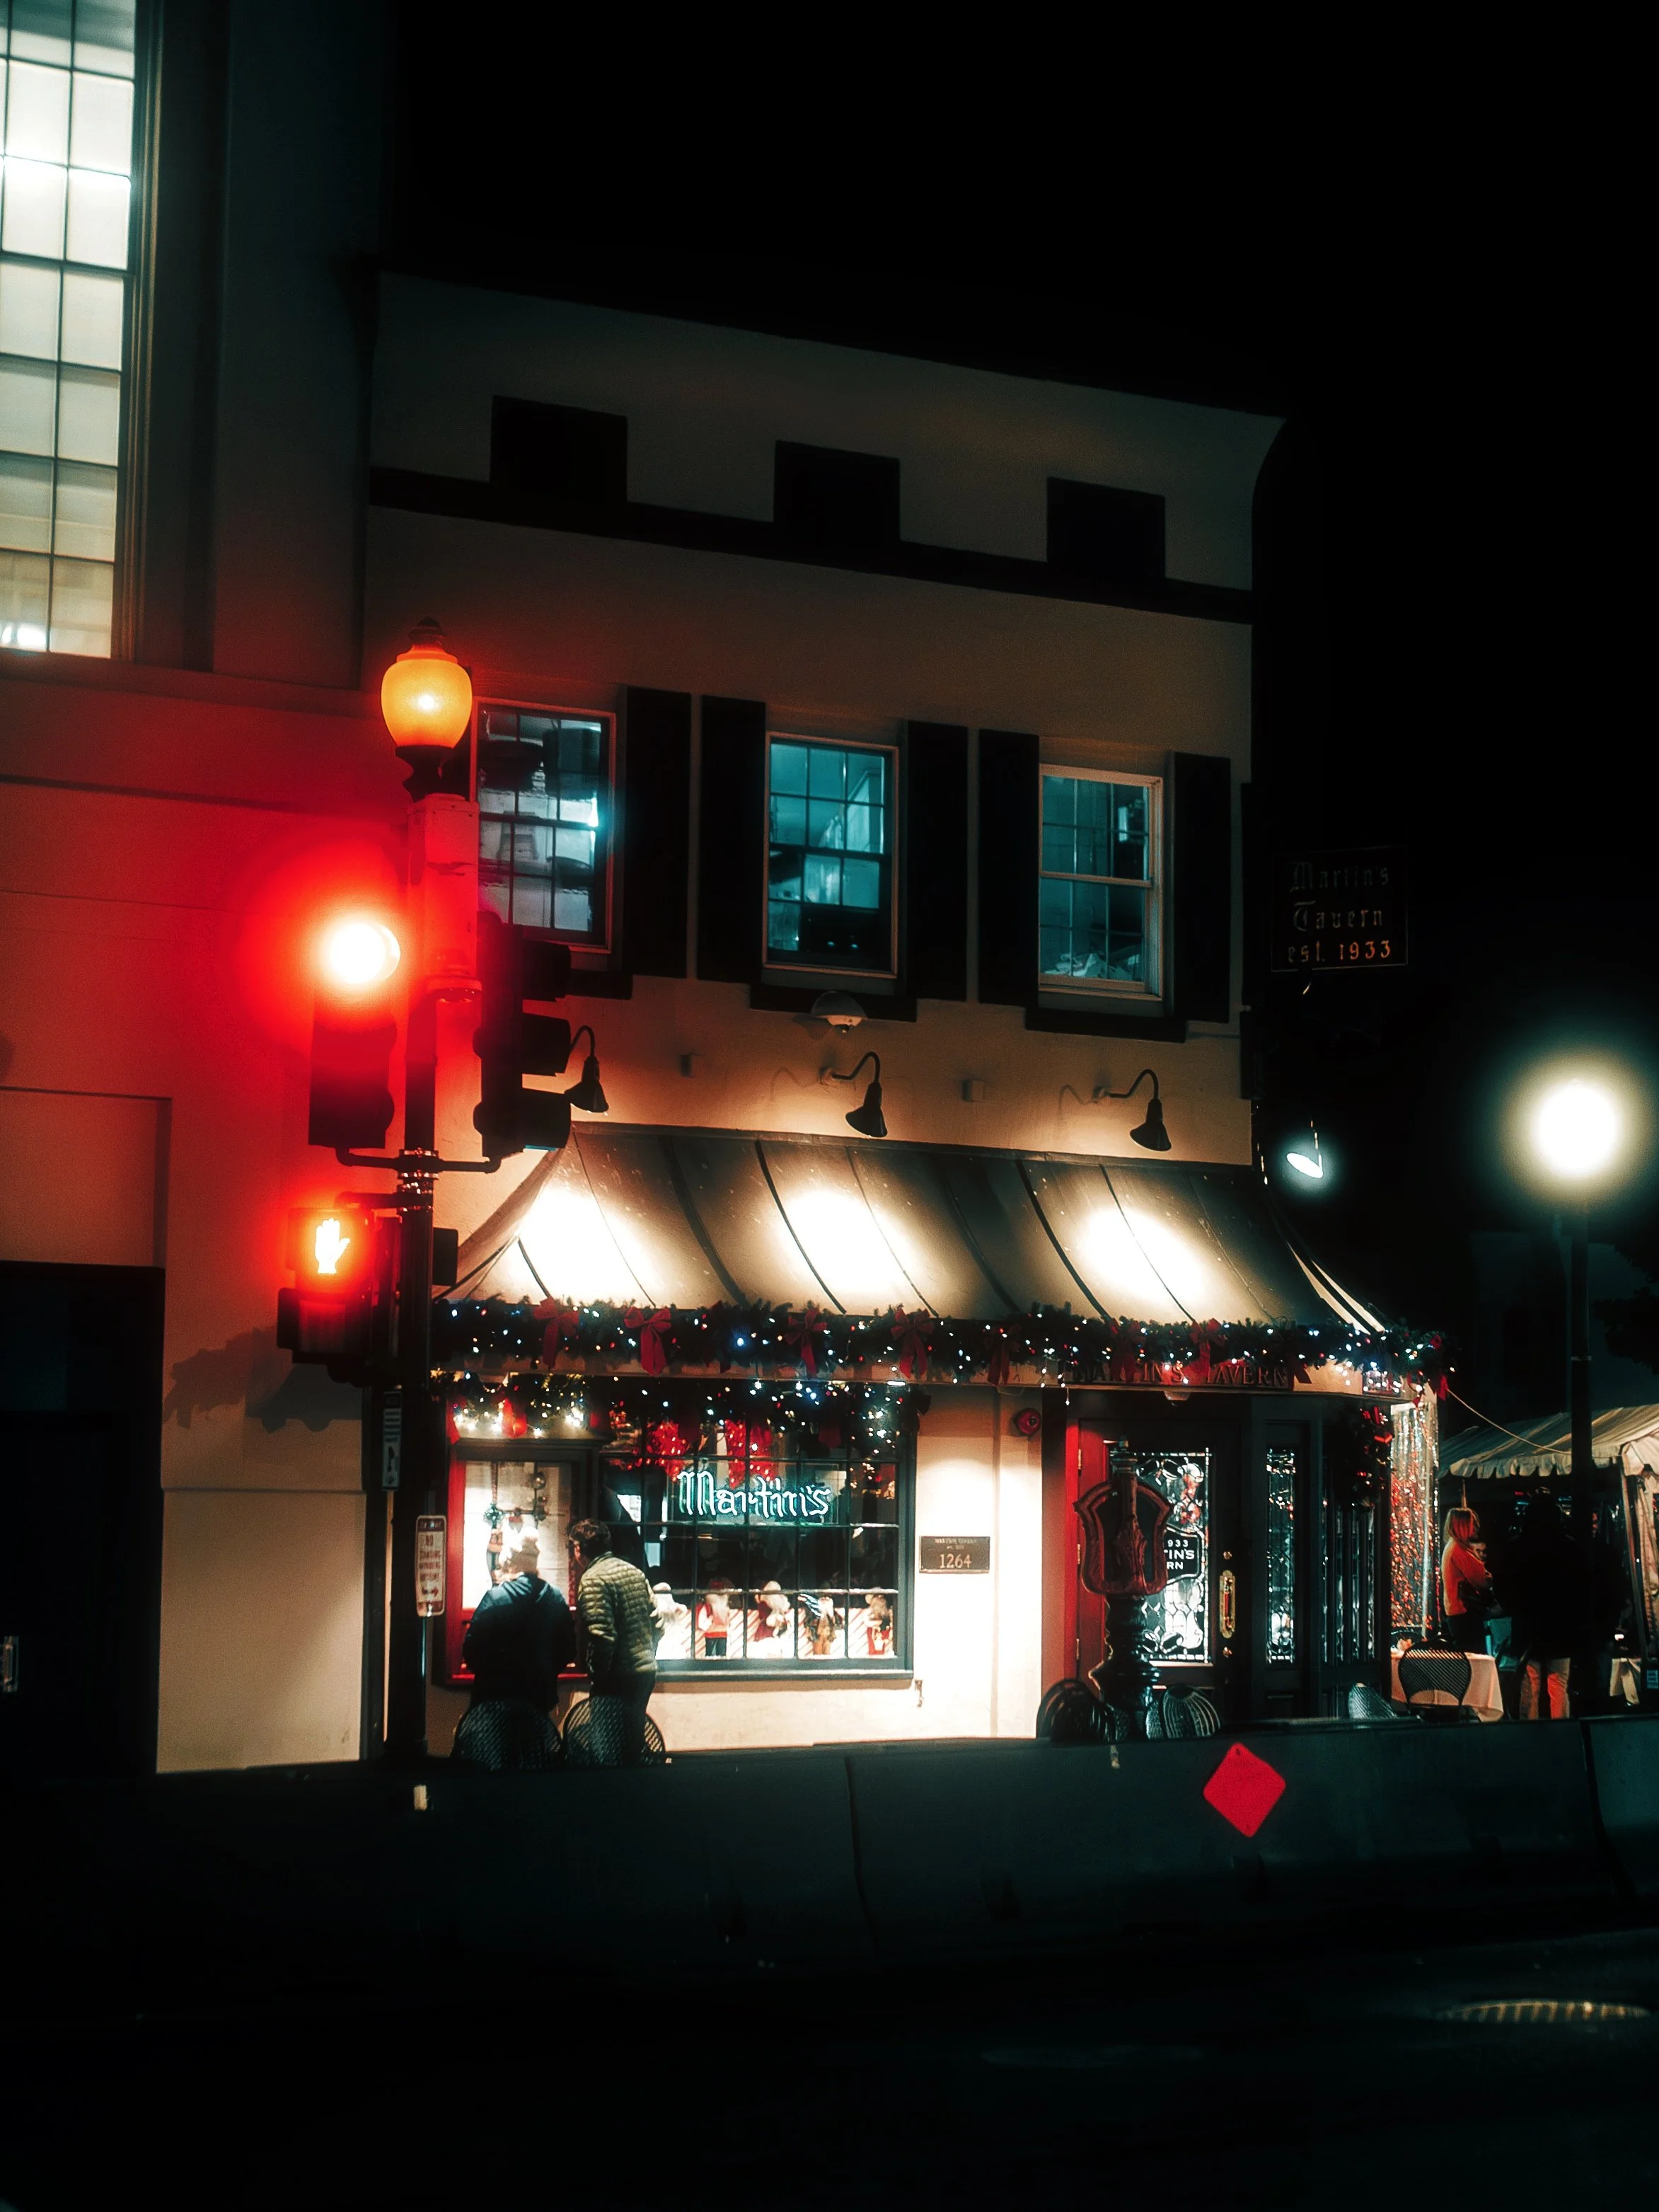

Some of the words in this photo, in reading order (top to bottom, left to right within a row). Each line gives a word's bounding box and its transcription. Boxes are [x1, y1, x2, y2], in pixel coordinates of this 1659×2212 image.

[1287, 860, 1390, 894] Martin's
[1293, 900, 1383, 932] Tavern
[1339, 939, 1392, 961] 1933
[676, 1470, 832, 1519] Martin's
[1167, 1539, 1189, 1548] 933
[940, 1553, 973, 1569] 1264
